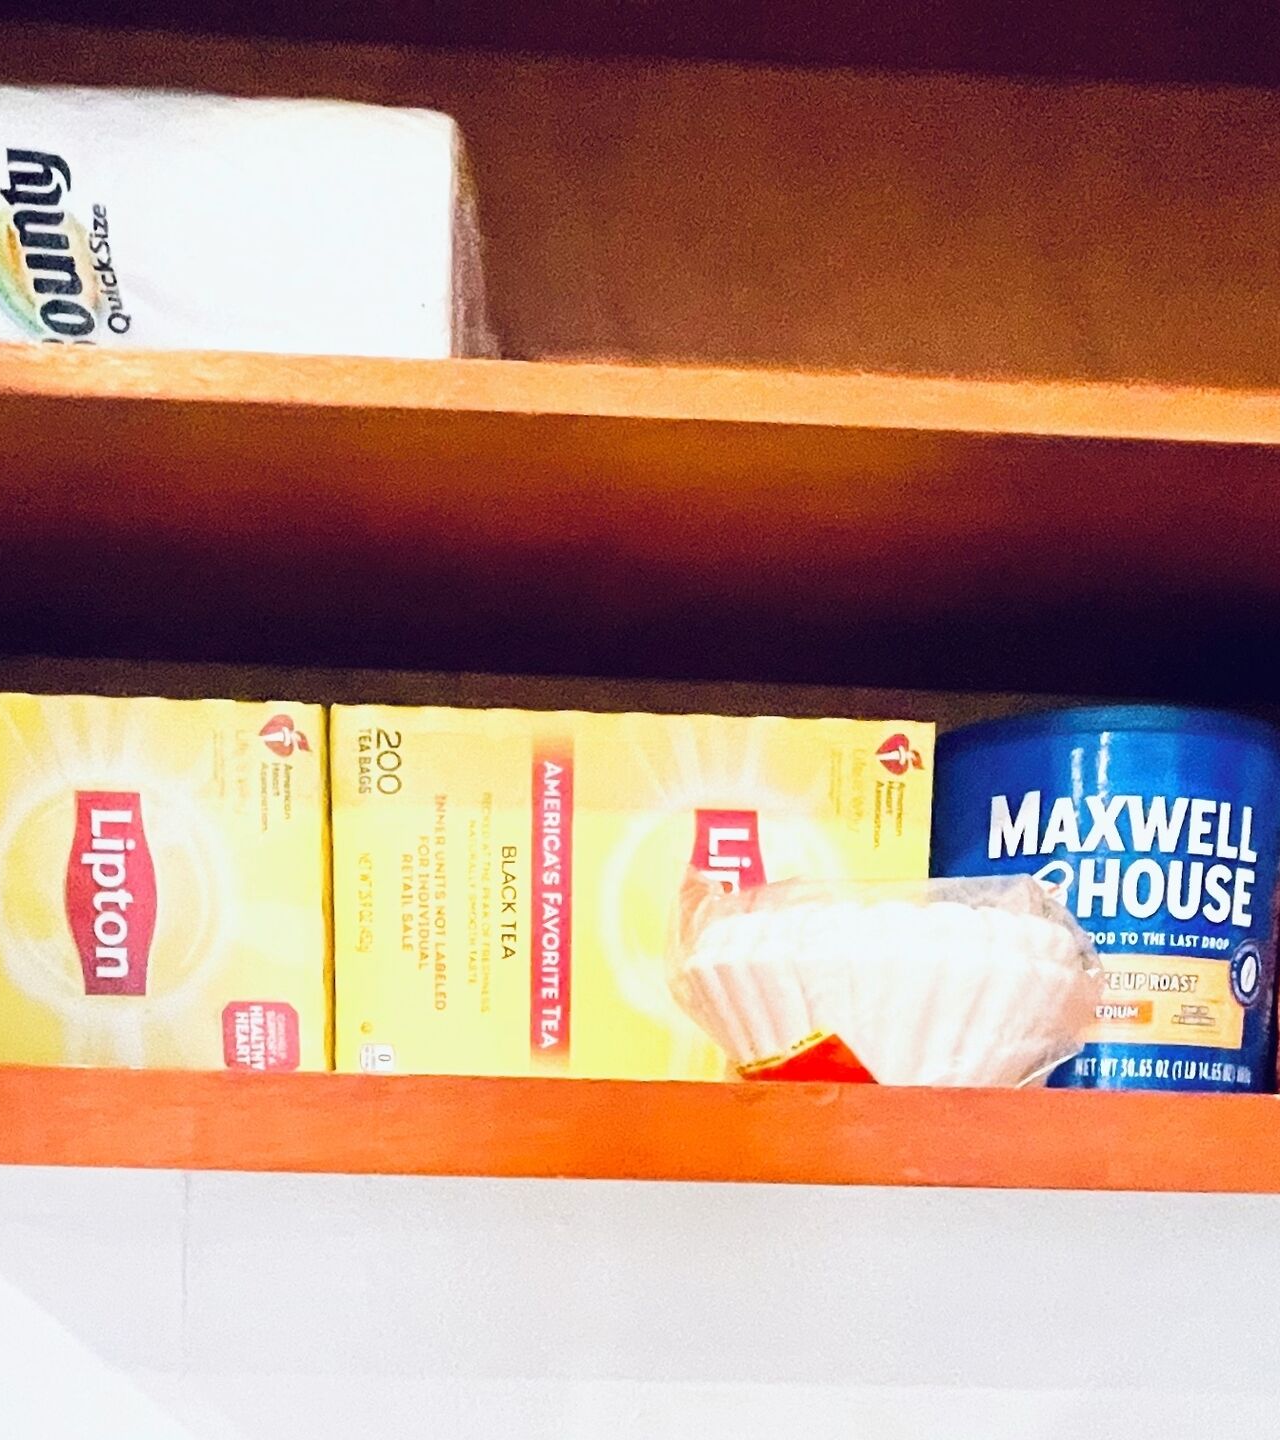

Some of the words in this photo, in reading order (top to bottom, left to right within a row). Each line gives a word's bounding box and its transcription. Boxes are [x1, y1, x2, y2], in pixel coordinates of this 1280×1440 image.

[0, 148, 96, 345] ounty
[359, 728, 372, 752] TEA
[377, 728, 402, 794] 200
[359, 756, 372, 794] BAGS
[434, 794, 447, 845] INNER
[542, 762, 563, 885] AMERICA'S
[988, 791, 1257, 863] MAXWELL
[418, 836, 429, 867] FOR
[434, 851, 446, 900] UNITS
[702, 827, 753, 896] Lip
[81, 809, 136, 978] Lipton
[402, 854, 413, 907] RETAIL
[501, 845, 517, 913] BLACK
[1076, 858, 1255, 928] HOUSE
[402, 913, 414, 952] SALE
[418, 874, 429, 971] INDIVIDUAL
[434, 905, 446, 936] NOT
[500, 922, 517, 959] TEA
[541, 892, 563, 1000] FAVORITE
[1120, 932, 1139, 945] TO
[1142, 932, 1165, 946] THE
[1170, 934, 1199, 948] LAST
[1201, 936, 1229, 950] DROP
[434, 942, 446, 1011] LABELED
[1123, 972, 1146, 991] UP
[1149, 973, 1199, 993] ROAST
[250, 1005, 265, 1071] HEALTHY
[541, 1005, 562, 1049] TEA
[1095, 1004, 1139, 1019] EDIUM
[235, 1012, 250, 1065] HEART
[1074, 1059, 1096, 1076] NET
[1155, 1060, 1170, 1079] OZ
